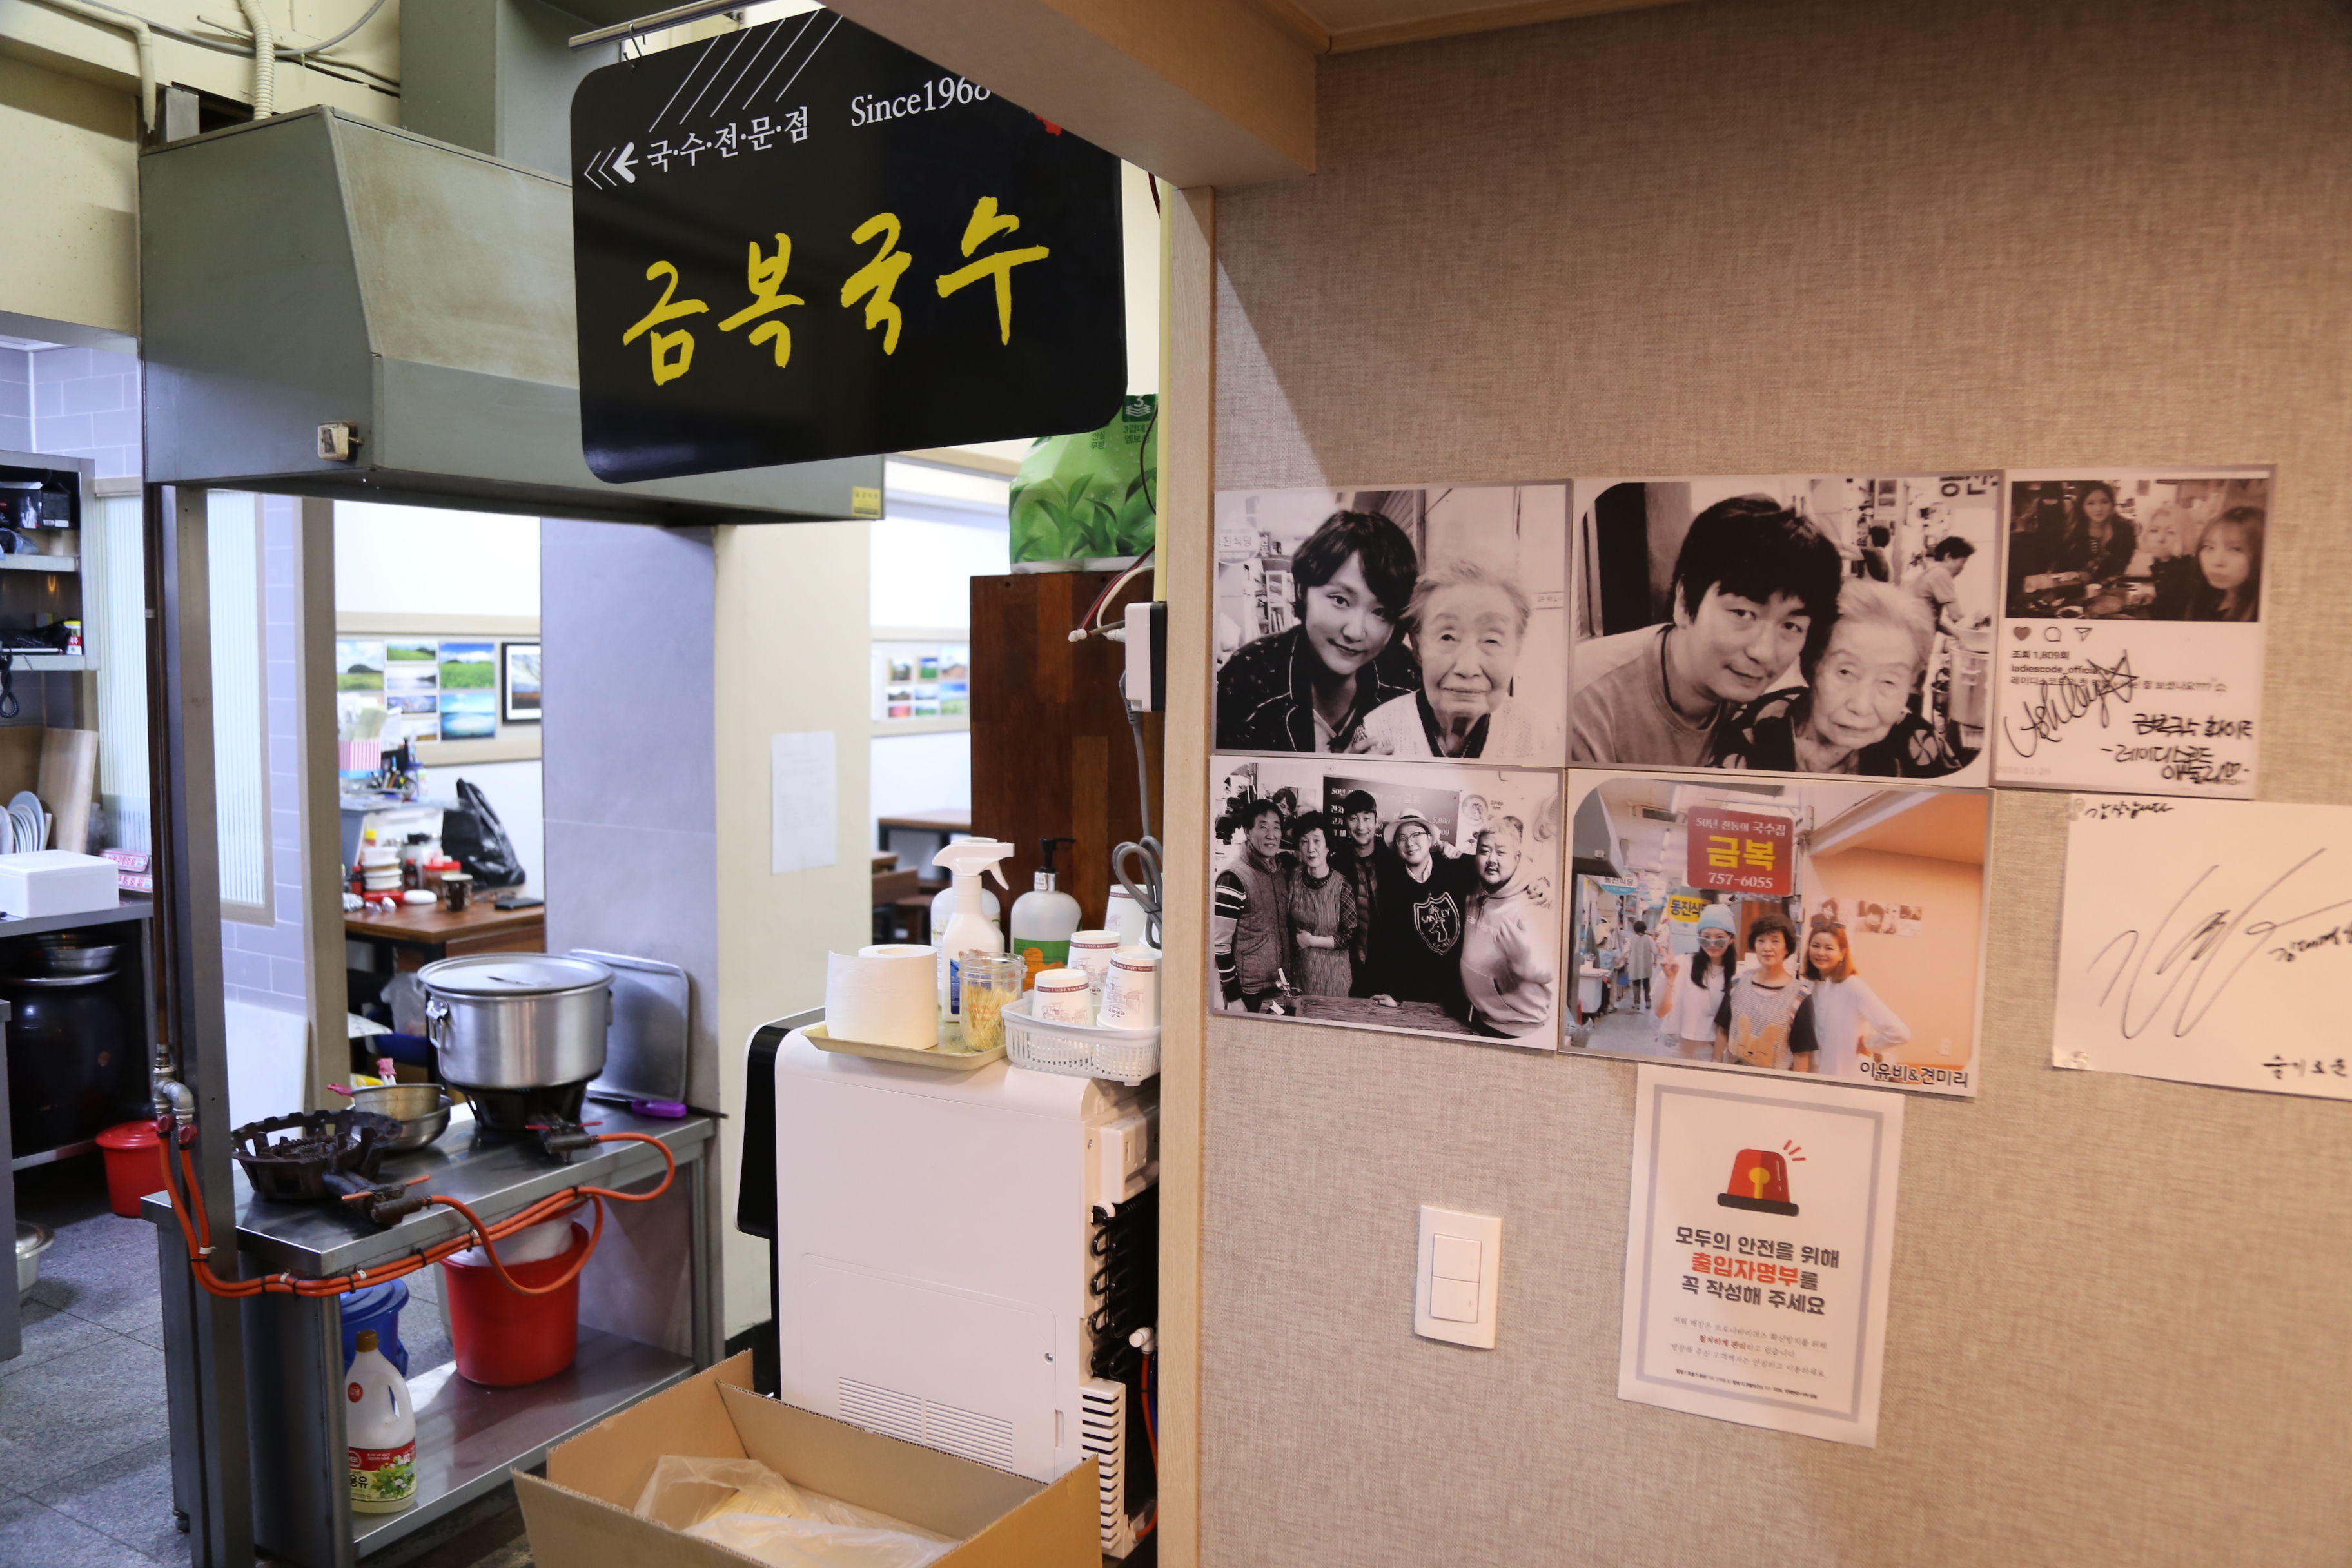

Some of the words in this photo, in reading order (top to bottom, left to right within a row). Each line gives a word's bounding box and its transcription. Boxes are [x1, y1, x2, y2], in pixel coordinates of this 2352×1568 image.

[623, 196, 1050, 386] 금복국수
[1696, 818, 1718, 829] 50년
[1752, 821, 1787, 837] 국수집
[1707, 835, 1776, 872] 금복
[1708, 872, 1774, 888] 757-6055
[1860, 1062, 1968, 1088] 이유비&견미리
[1676, 1226, 1731, 1252] 모두의
[1738, 1236, 1794, 1262] 안전을
[1801, 1246, 1840, 1269] 위해
[1692, 1252, 1819, 1291] 출입자명부를
[1682, 1275, 1700, 1295] 꼭
[1706, 1279, 1762, 1306] 작성해
[1768, 1289, 1826, 1315] 주세요
